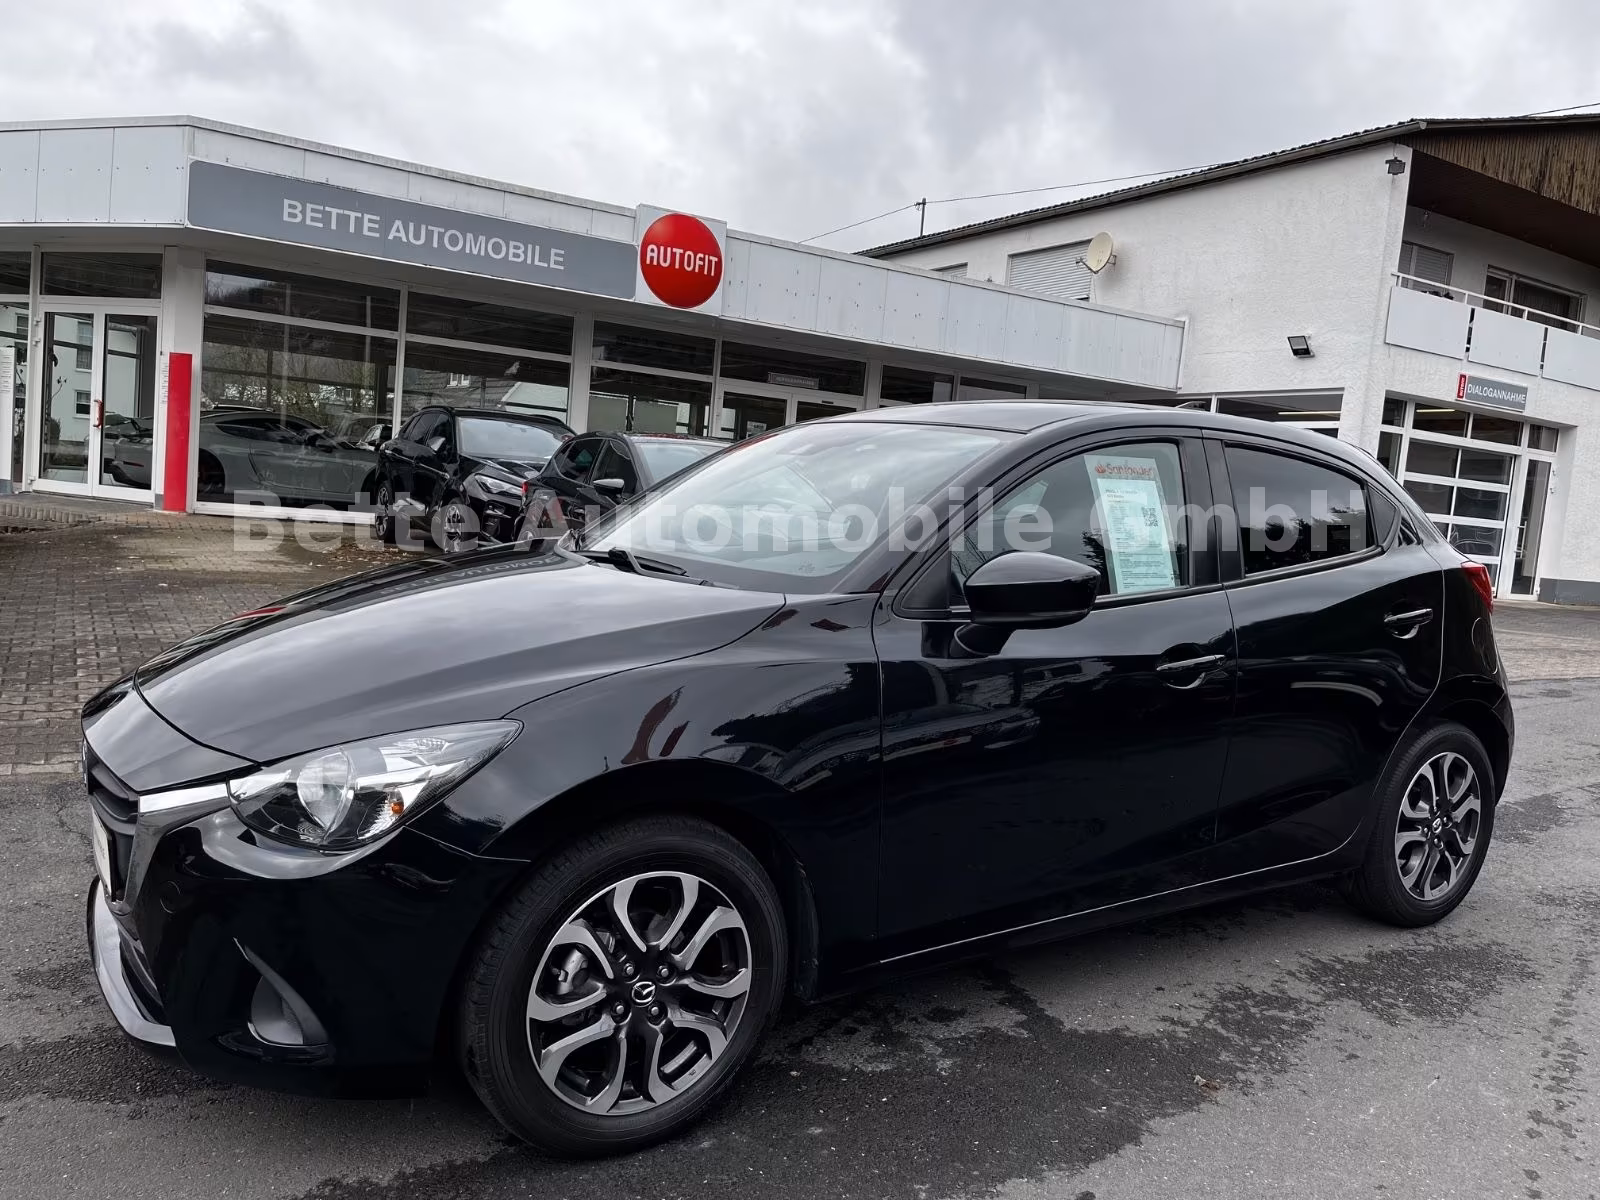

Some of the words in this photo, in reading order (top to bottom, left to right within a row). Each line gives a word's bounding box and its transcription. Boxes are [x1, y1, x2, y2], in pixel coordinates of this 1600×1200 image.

[283, 199, 380, 238] BETTE
[388, 219, 566, 270] AUTOMOBILE
[646, 244, 718, 277] AUTOFIT
[1467, 384, 1526, 404] DIALOGANNAHME
